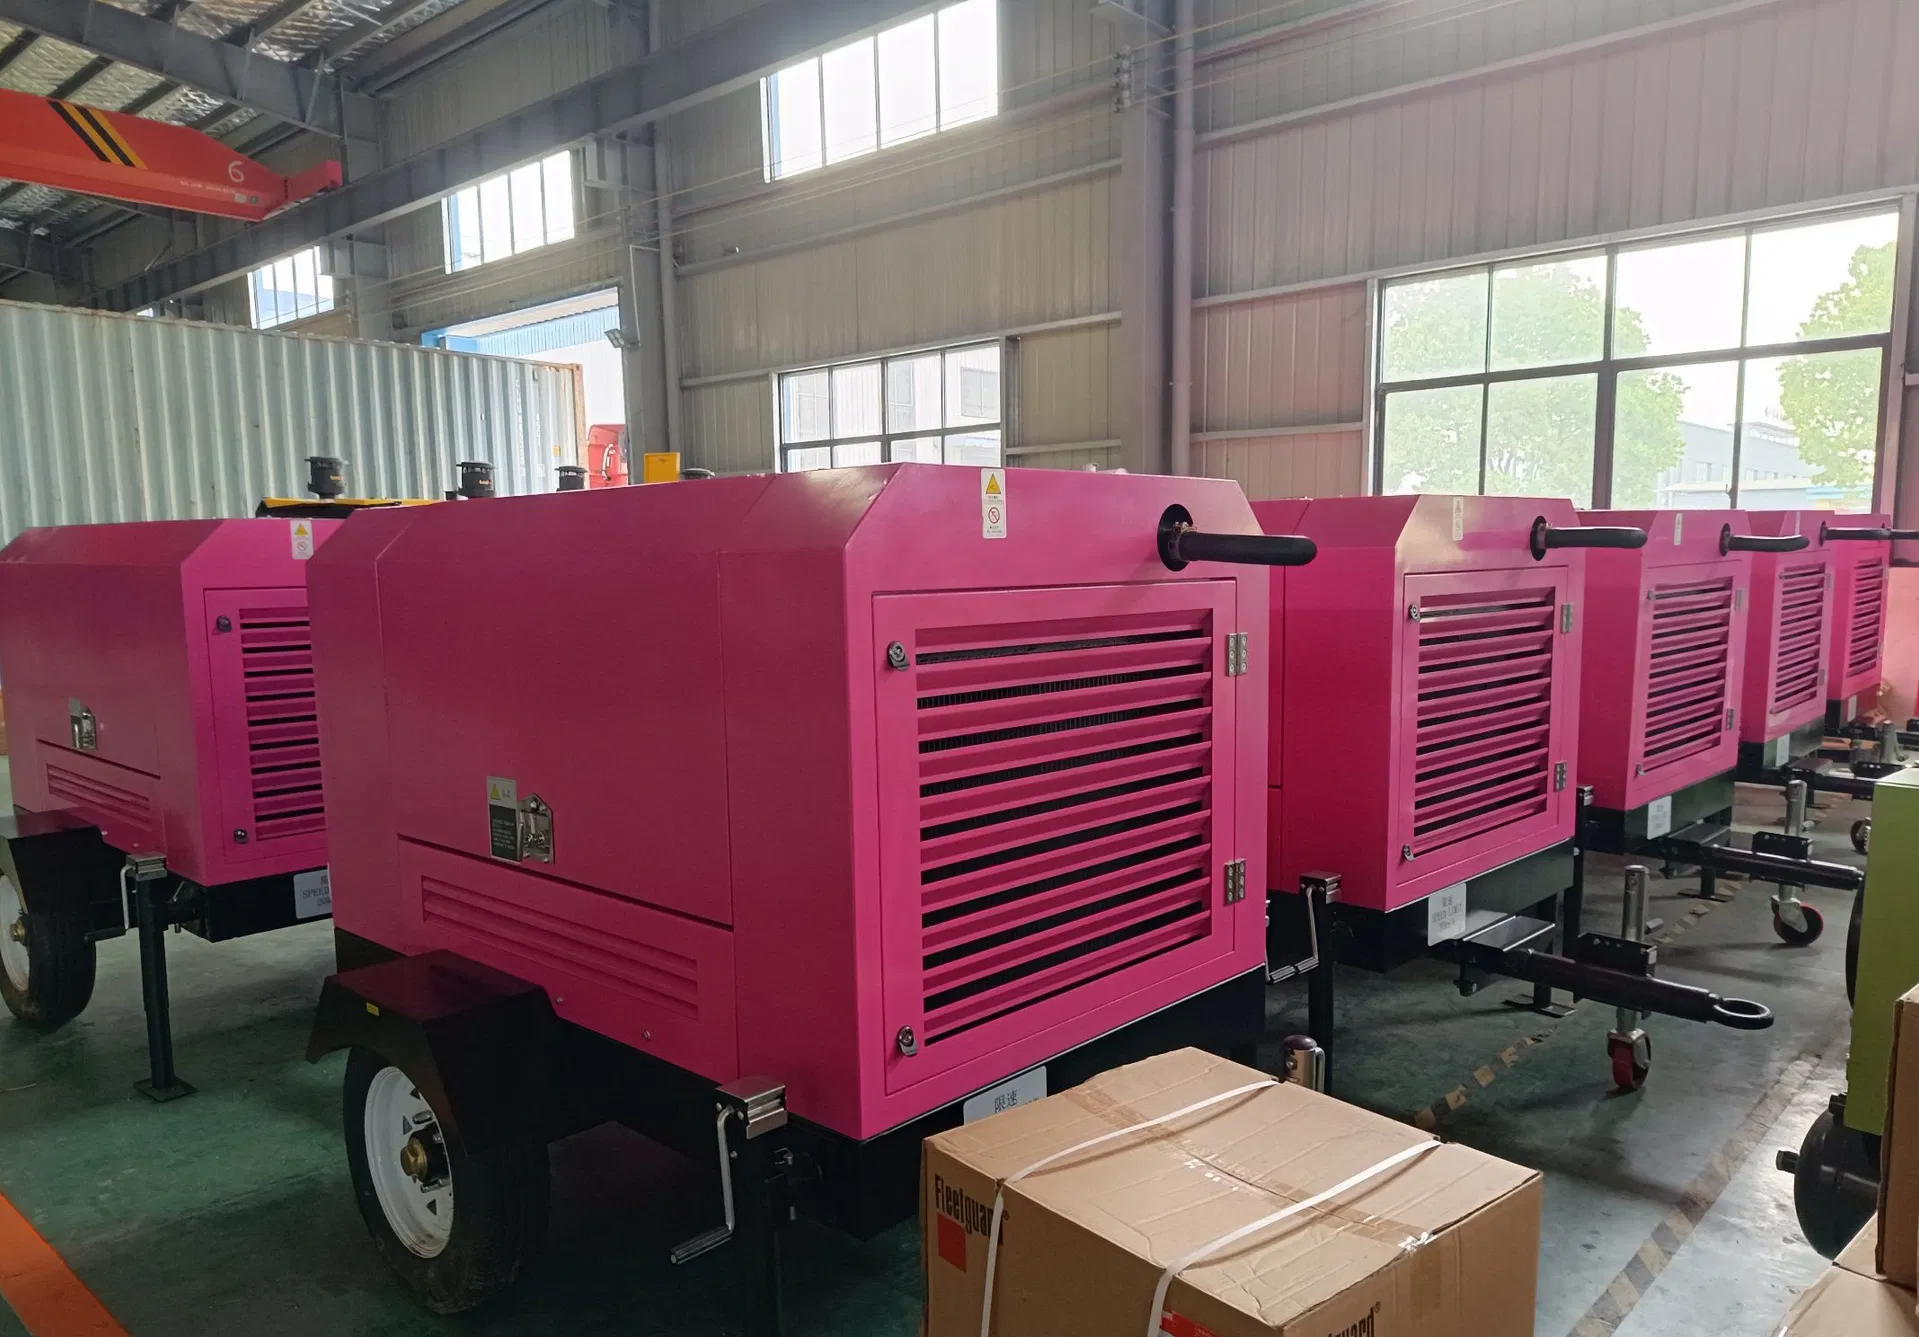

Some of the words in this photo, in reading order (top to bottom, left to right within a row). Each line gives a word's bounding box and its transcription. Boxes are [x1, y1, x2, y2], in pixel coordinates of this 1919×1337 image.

[228, 160, 245, 183] 6
[994, 1089, 1018, 1114] 限速
[934, 1173, 1004, 1246] Fleetguar
